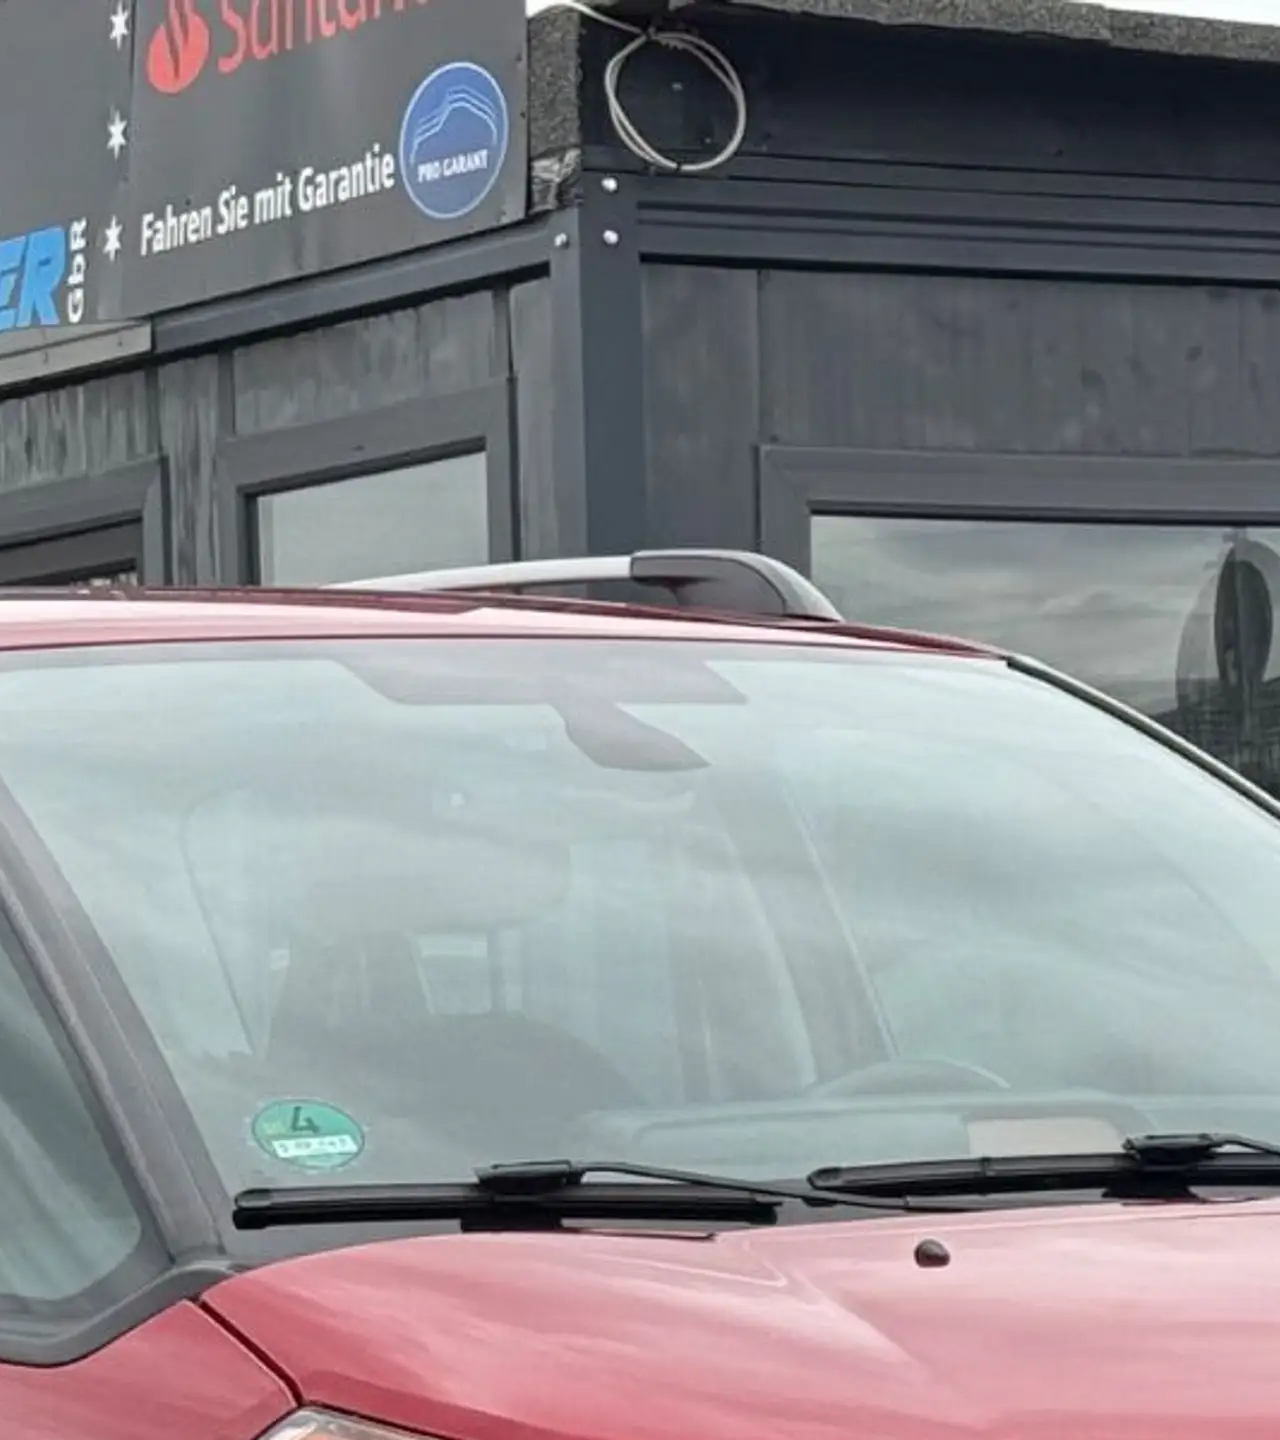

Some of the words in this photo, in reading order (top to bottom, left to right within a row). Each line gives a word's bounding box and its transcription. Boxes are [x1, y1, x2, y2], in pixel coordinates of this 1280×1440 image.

[140, 205, 213, 256] Fahren
[216, 184, 248, 235] Sie
[254, 172, 293, 224] mit
[298, 143, 395, 212] Garantie
[417, 160, 440, 183] PRO
[443, 149, 488, 177] GARANT
[66, 217, 87, 324] GbR
[290, 1105, 321, 1134] 4
